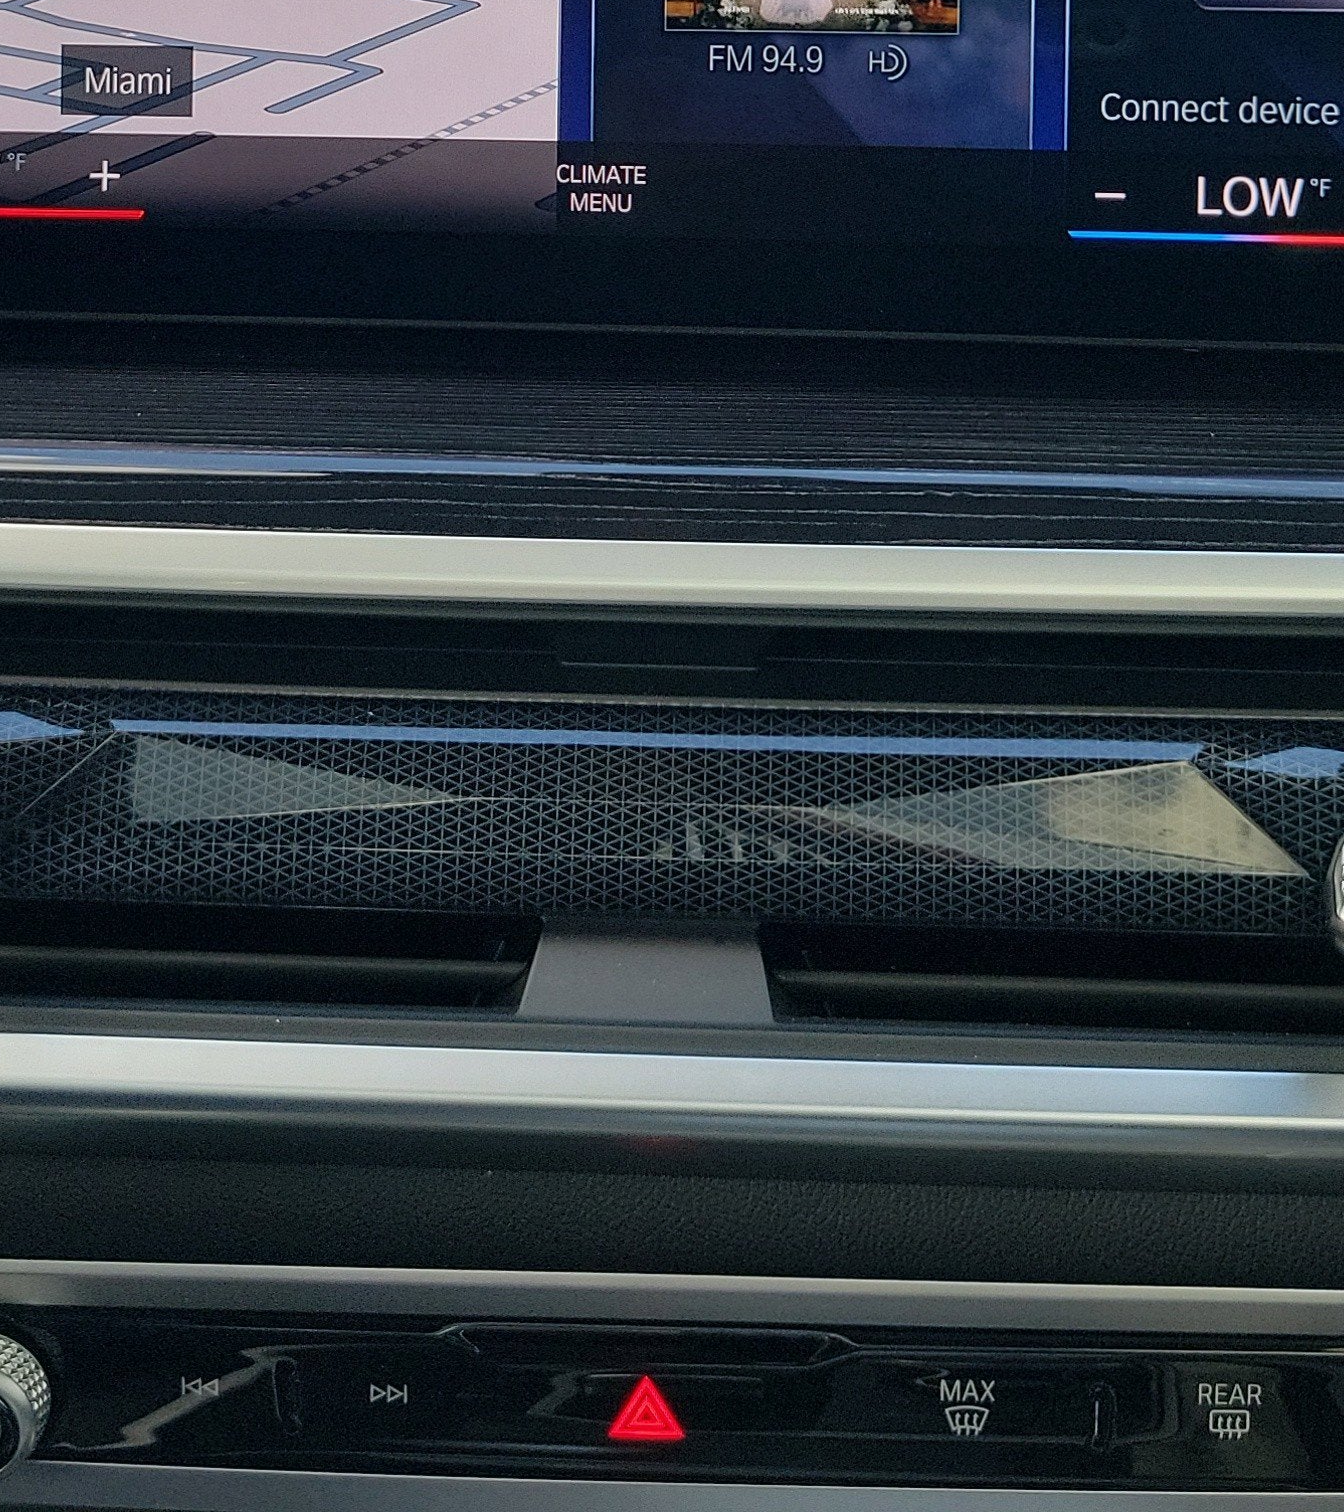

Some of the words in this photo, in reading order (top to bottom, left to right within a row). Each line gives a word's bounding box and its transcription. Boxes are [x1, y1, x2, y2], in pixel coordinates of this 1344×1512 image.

[708, 44, 753, 73] FM
[761, 44, 824, 74] 94.9
[84, 66, 172, 96] Miami
[1100, 92, 1230, 123] Connect
[1237, 95, 1341, 126] device
[555, 164, 647, 186] CLIMATE
[569, 192, 633, 214] MENU
[1196, 175, 1304, 218] LOW
[939, 1379, 997, 1403] MAX
[1197, 1382, 1263, 1405] REAR
